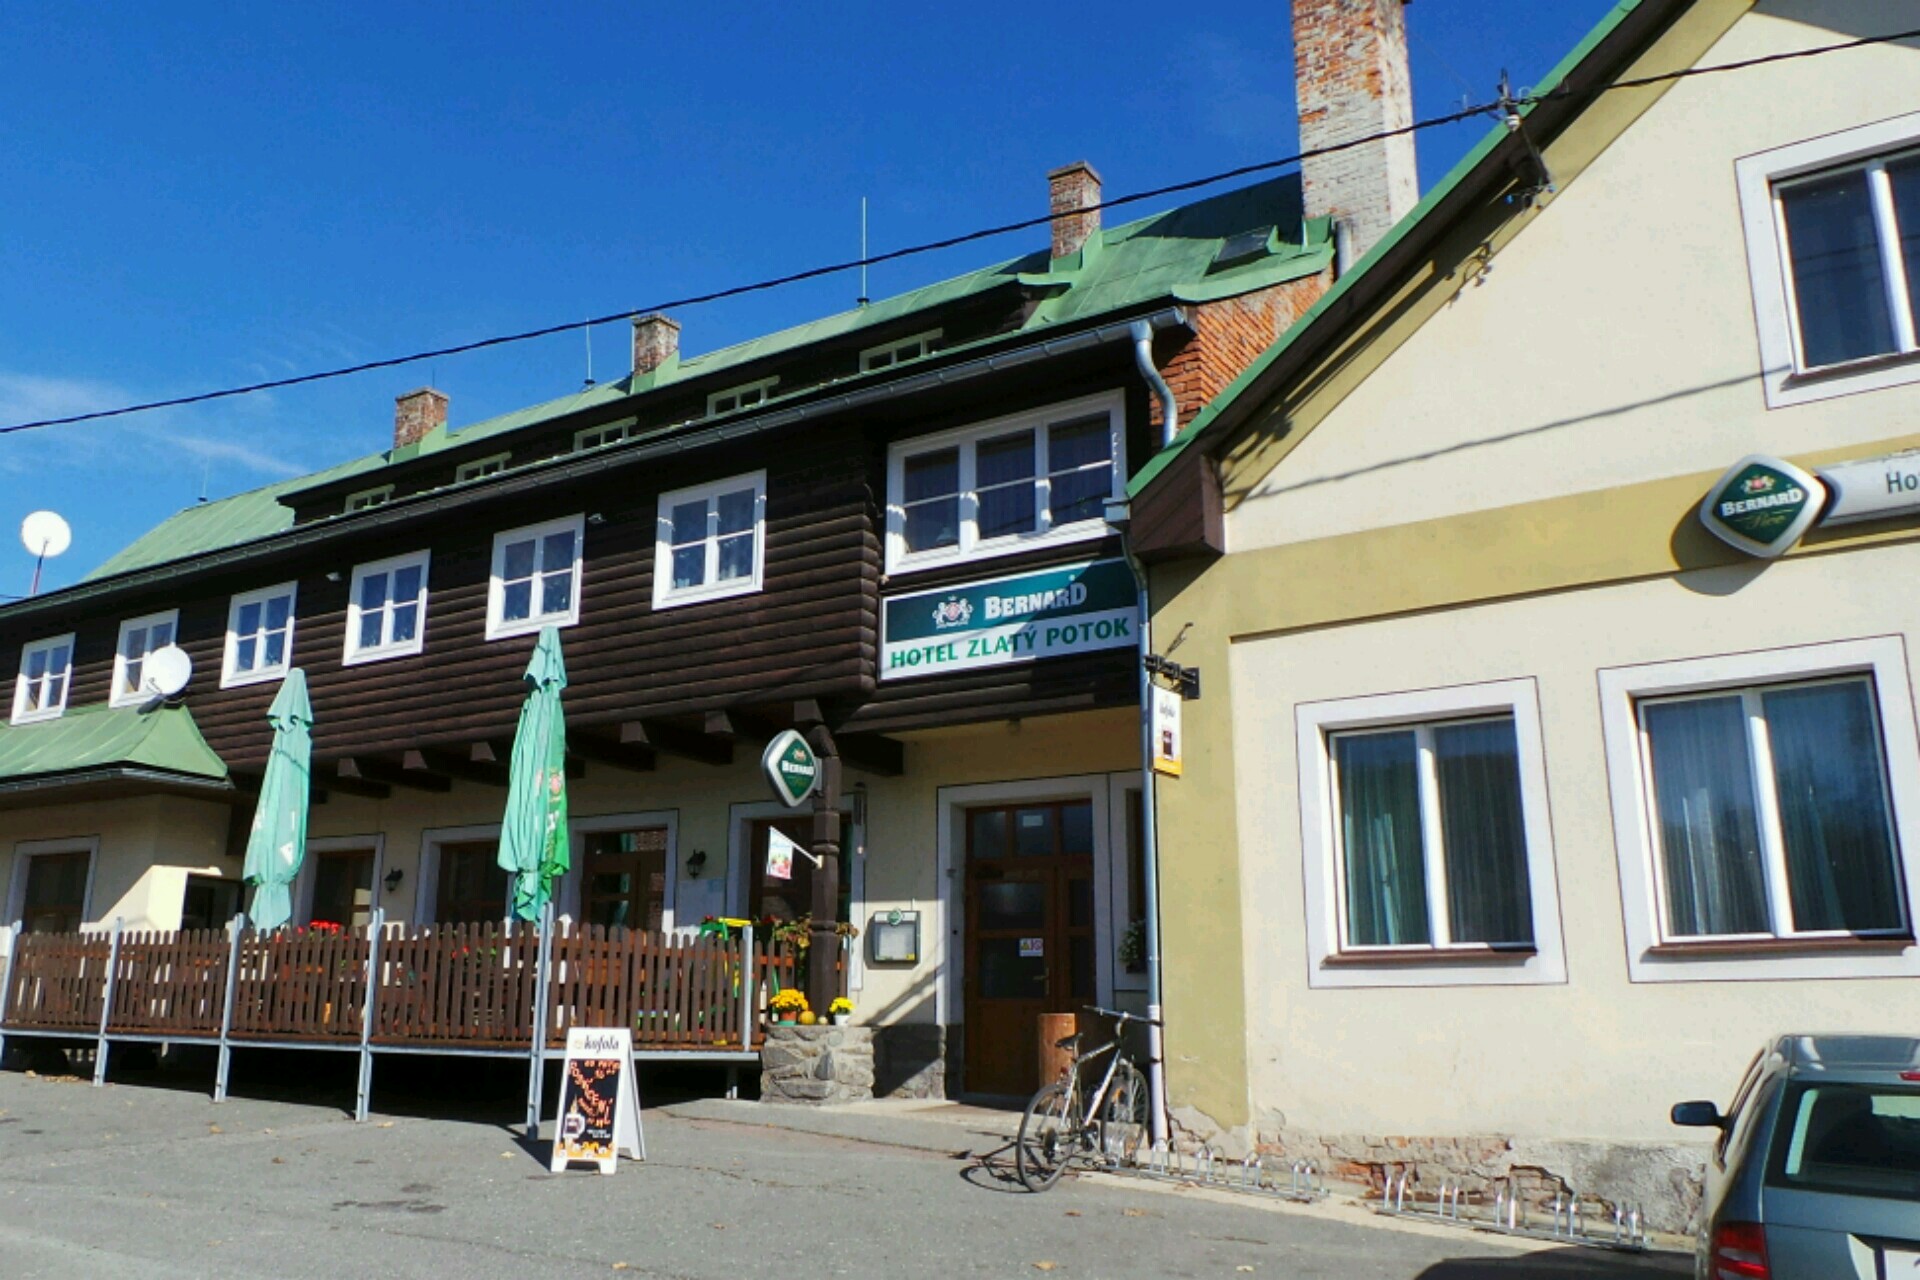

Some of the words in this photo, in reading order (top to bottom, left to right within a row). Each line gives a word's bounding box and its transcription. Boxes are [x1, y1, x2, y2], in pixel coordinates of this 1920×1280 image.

[1886, 470, 1920, 495] Ho
[1721, 488, 1803, 517] BERNARD
[985, 583, 1087, 620] BERNARD
[890, 642, 959, 669] HOTEL
[967, 625, 1038, 658] ZLATÝ
[1046, 618, 1131, 647] POTOK
[584, 1036, 619, 1053] kofola
